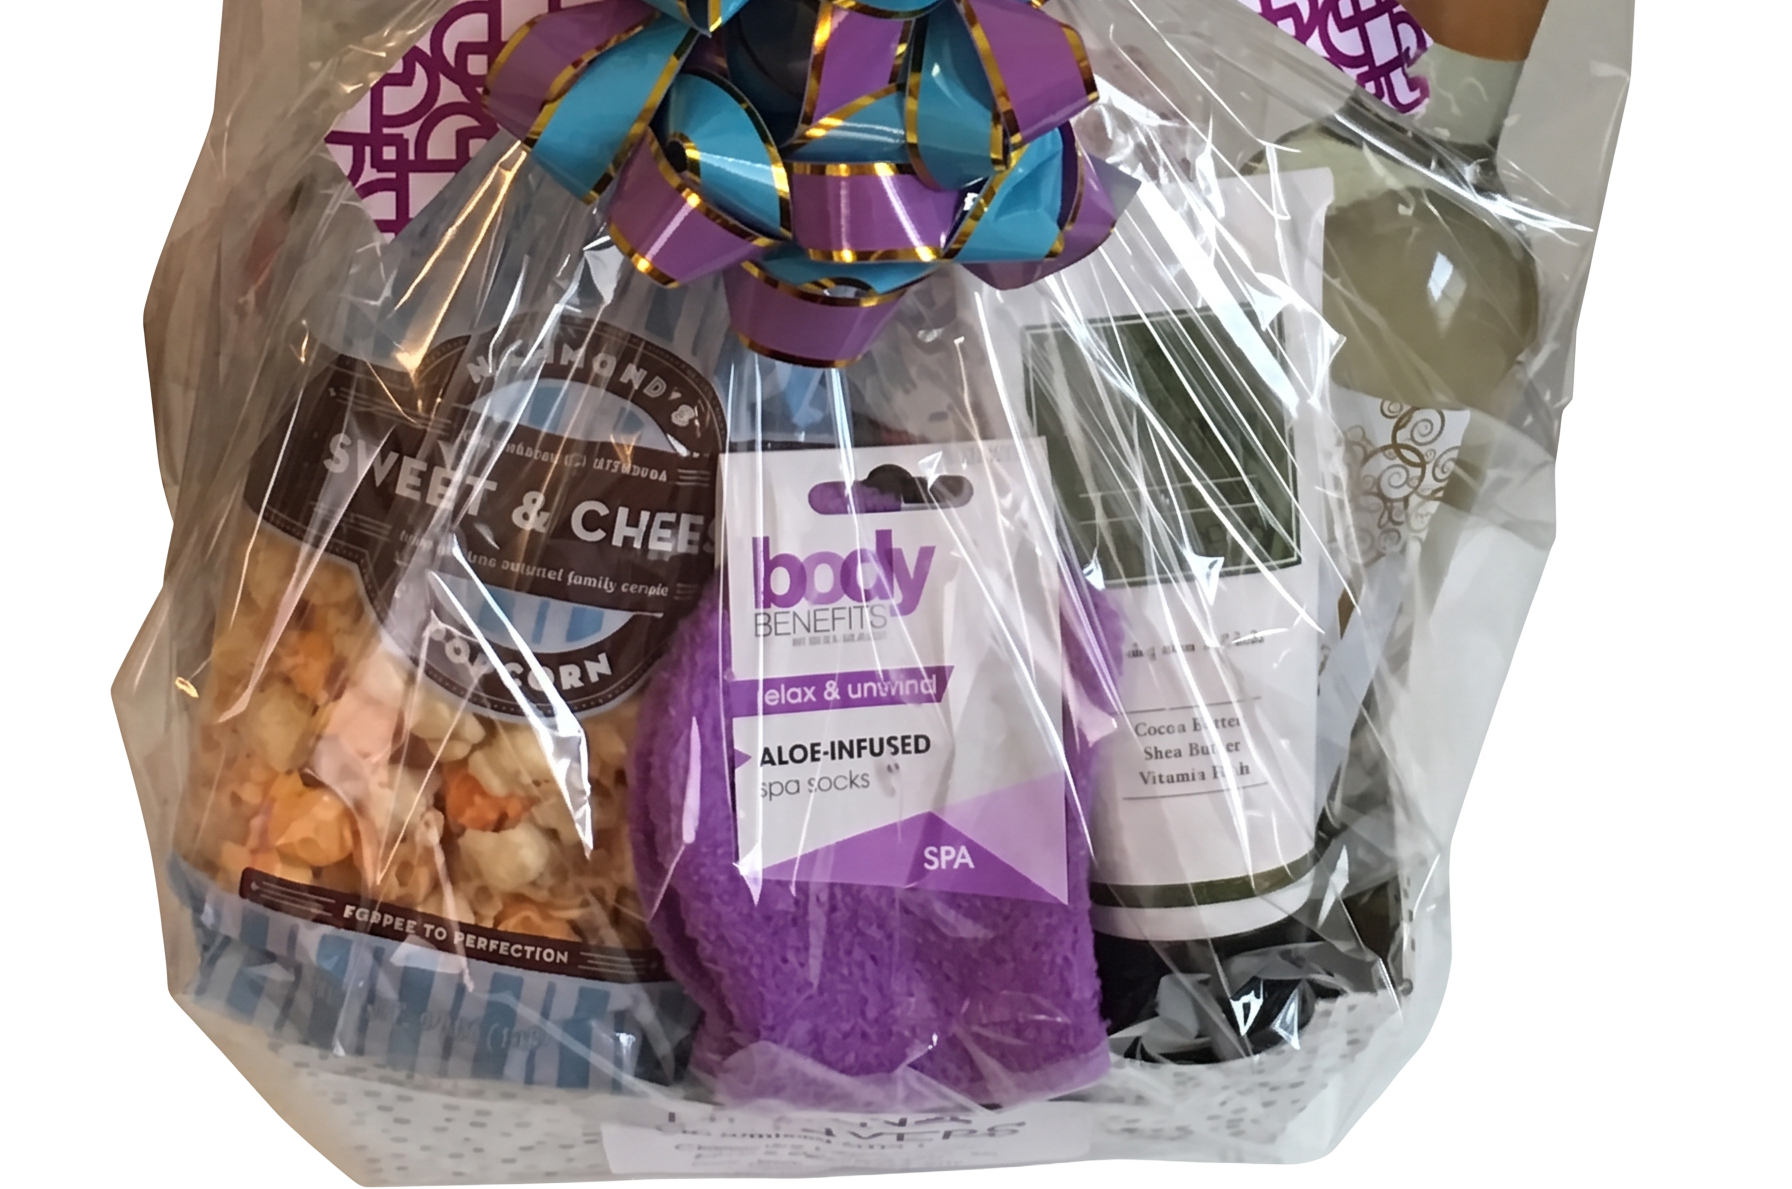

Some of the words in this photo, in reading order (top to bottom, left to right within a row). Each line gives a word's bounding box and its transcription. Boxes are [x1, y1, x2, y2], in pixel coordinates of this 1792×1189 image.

[323, 432, 498, 516] SWEET
[511, 491, 550, 534] &
[752, 529, 936, 617] body
[754, 604, 887, 638] BENEFITS
[758, 682, 817, 707] elax
[823, 680, 841, 701] &
[848, 674, 937, 699] unwind
[1192, 716, 1241, 732] Btter
[760, 734, 931, 767] ALOE-INFUSED
[1144, 744, 1182, 761] Shea
[1188, 740, 1241, 757] Buter
[760, 778, 800, 801] spa
[808, 770, 870, 794] socks
[923, 845, 975, 871] SPA
[423, 923, 447, 941] TO
[453, 930, 568, 964] PERFECTION
